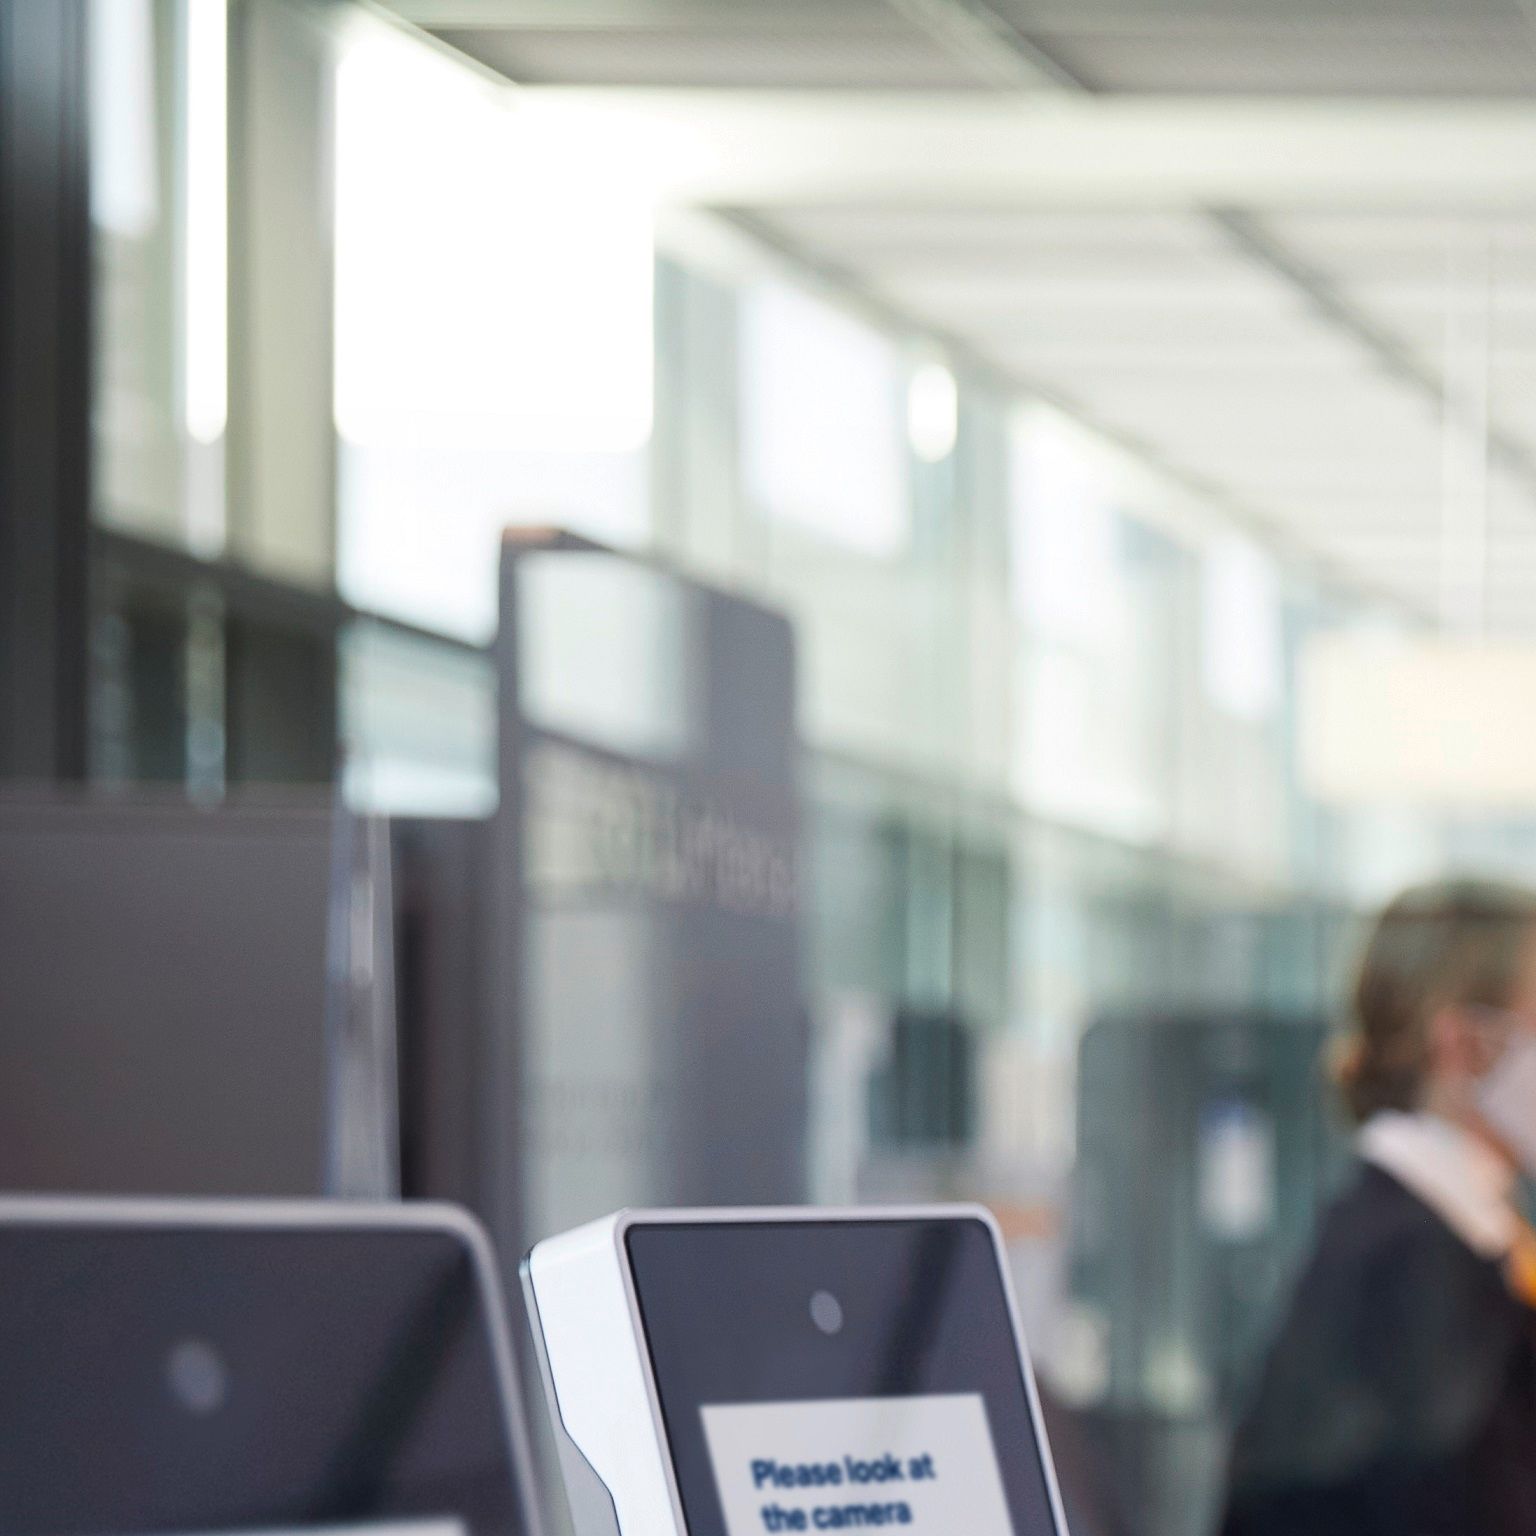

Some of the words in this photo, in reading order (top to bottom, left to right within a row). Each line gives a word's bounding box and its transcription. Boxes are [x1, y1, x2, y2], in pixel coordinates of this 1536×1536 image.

[751, 1458, 842, 1490] Please
[844, 1452, 904, 1484] look
[908, 1453, 936, 1481] at
[761, 1503, 808, 1534] the
[812, 1501, 912, 1531] camera
